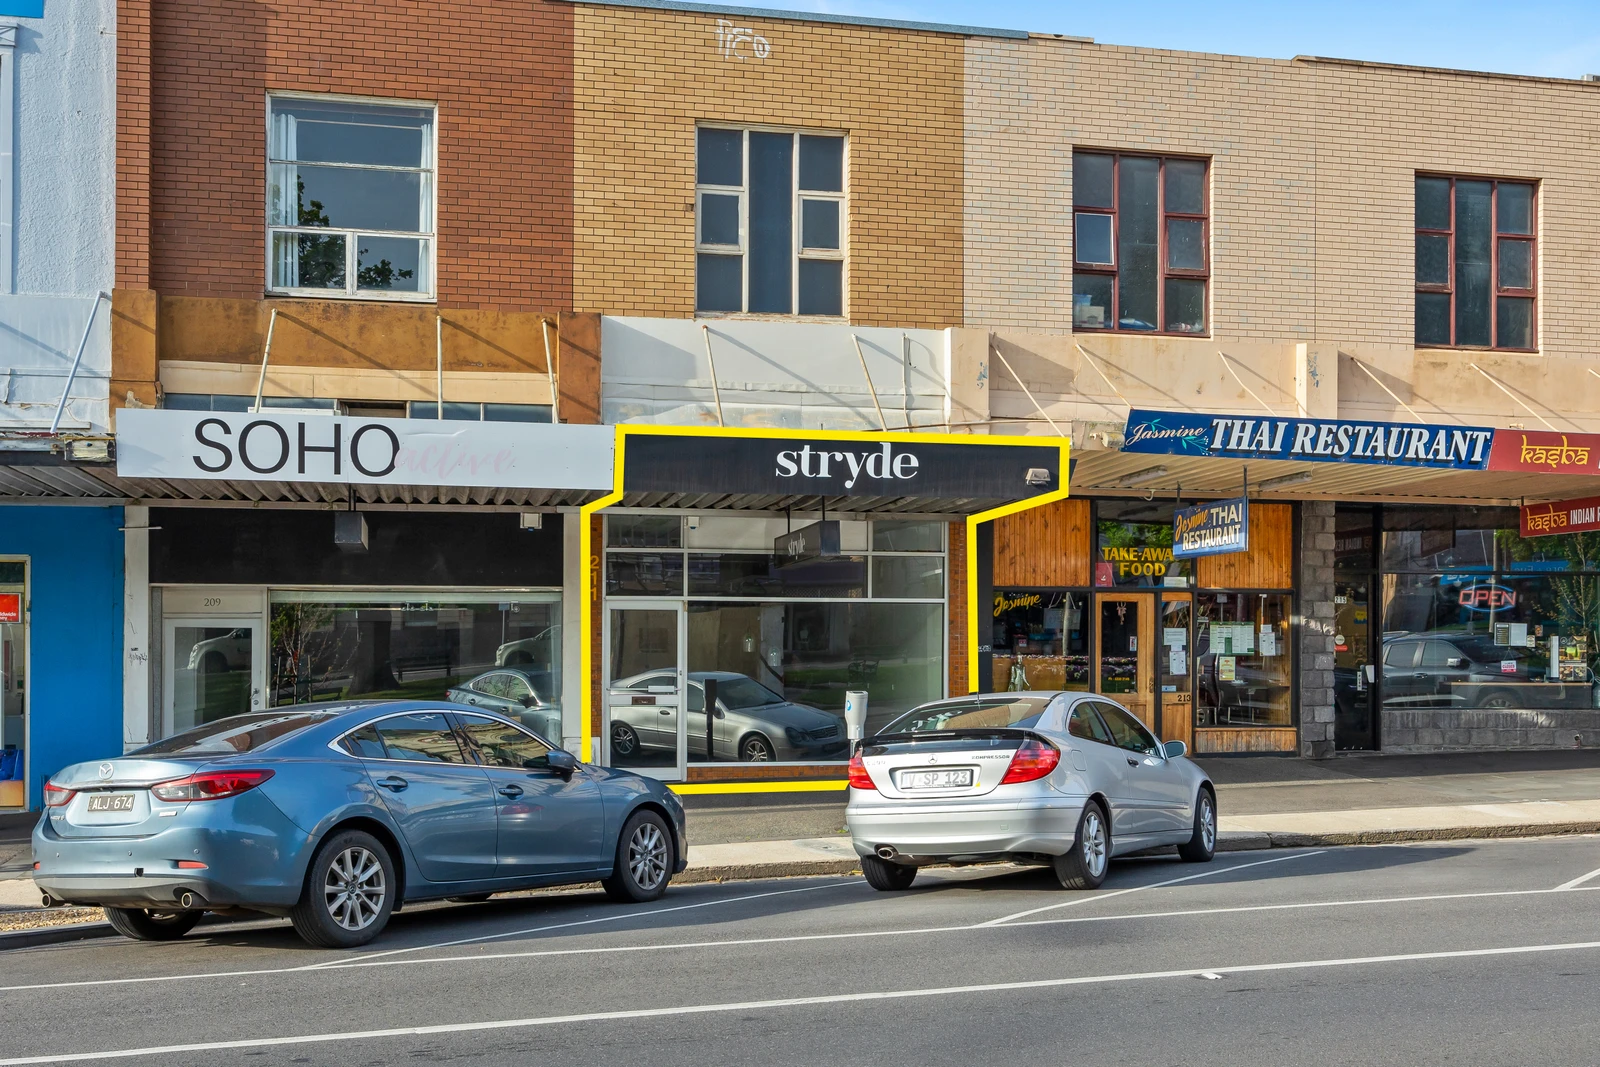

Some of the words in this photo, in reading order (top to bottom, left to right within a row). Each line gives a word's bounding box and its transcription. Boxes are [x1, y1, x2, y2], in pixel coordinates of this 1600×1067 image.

[192, 418, 400, 477] SOHO
[394, 442, 516, 479] active
[1125, 423, 1207, 446] Jasmine
[1208, 418, 1289, 453] THAI
[1290, 422, 1491, 463] RESTAURANT
[1520, 434, 1591, 468] kasba
[775, 442, 919, 489] stryde
[1175, 508, 1209, 542] Jasmine
[1210, 502, 1243, 525] THAI
[1526, 504, 1567, 531] kasba
[1570, 507, 1595, 525] INDIAN
[788, 533, 806, 560] stryde
[1182, 525, 1241, 551] RESTAURANT
[1102, 547, 1175, 561] TAKE-AWA
[1119, 562, 1166, 576] FOOD
[204, 598, 221, 606] 209
[993, 593, 1041, 617] Jasmine
[1459, 590, 1517, 606] OPEN
[1177, 694, 1191, 702] 213
[945, 771, 967, 785] 123
